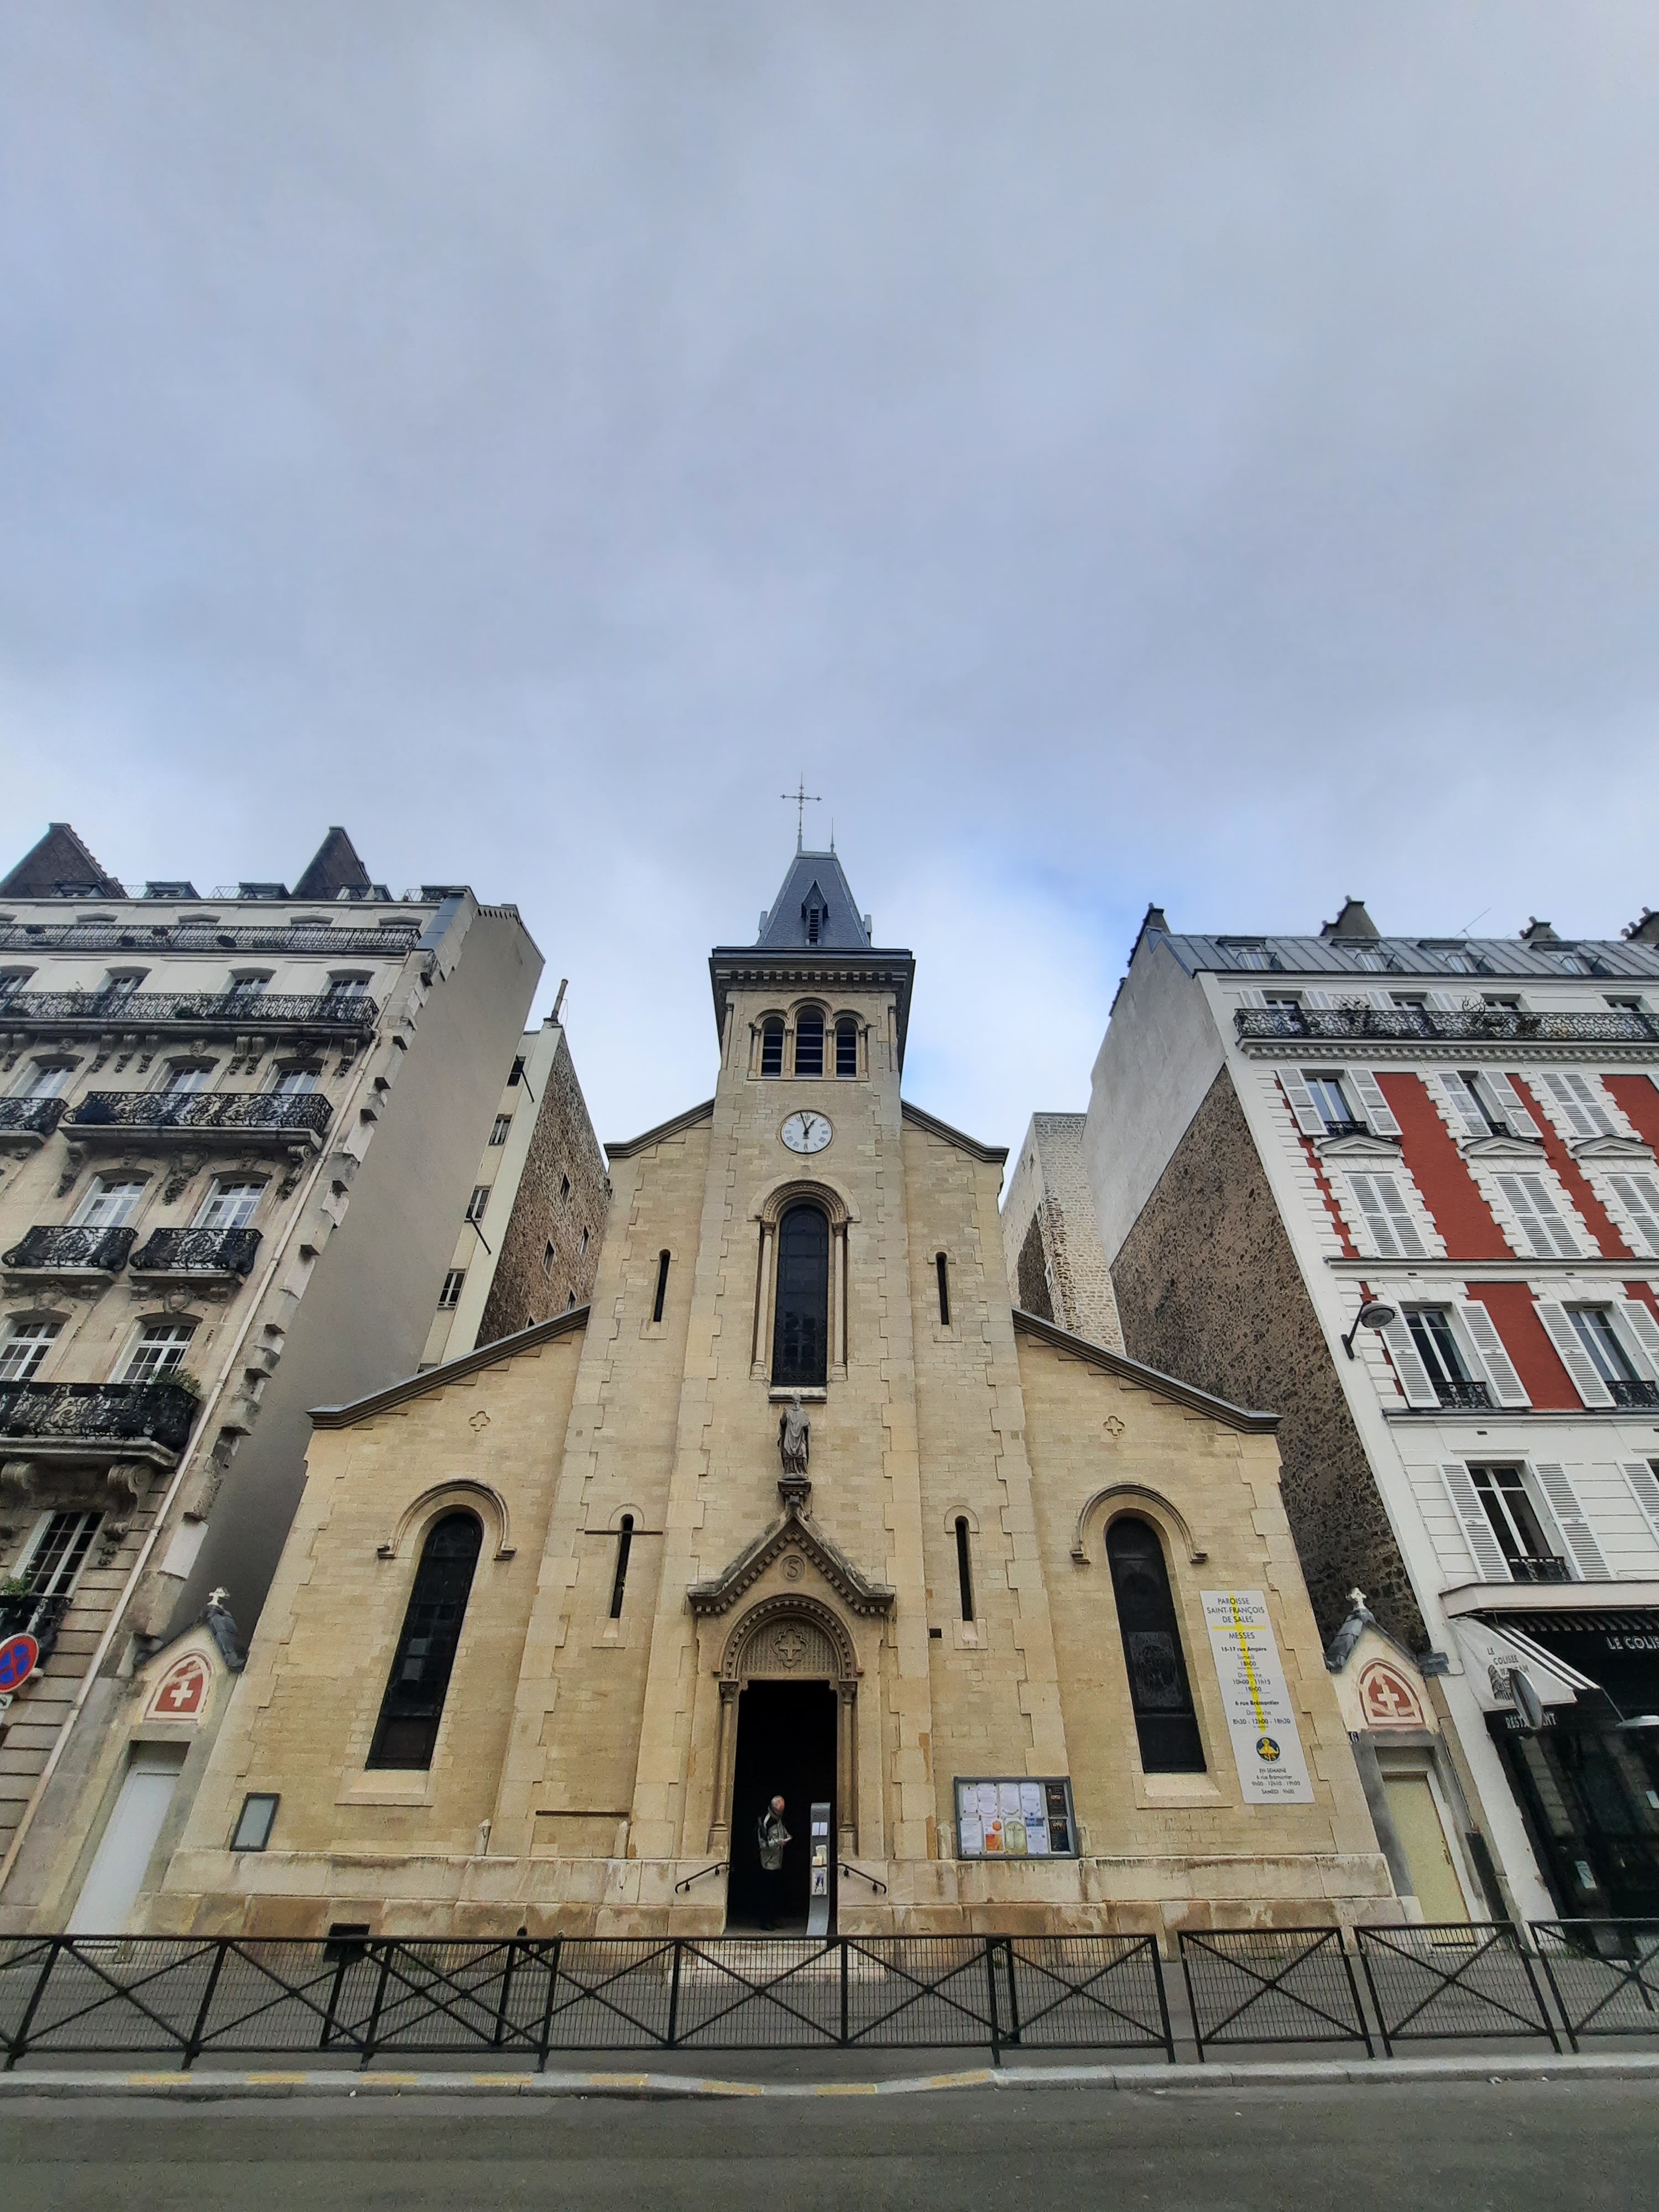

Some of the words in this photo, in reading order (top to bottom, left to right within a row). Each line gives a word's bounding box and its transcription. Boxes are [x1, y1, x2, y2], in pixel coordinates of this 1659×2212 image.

[1207, 1606, 1265, 1615] SAINT-FRANÇOIS
[1606, 1636, 1624, 1650] LE
[1487, 1647, 1495, 1655] LE
